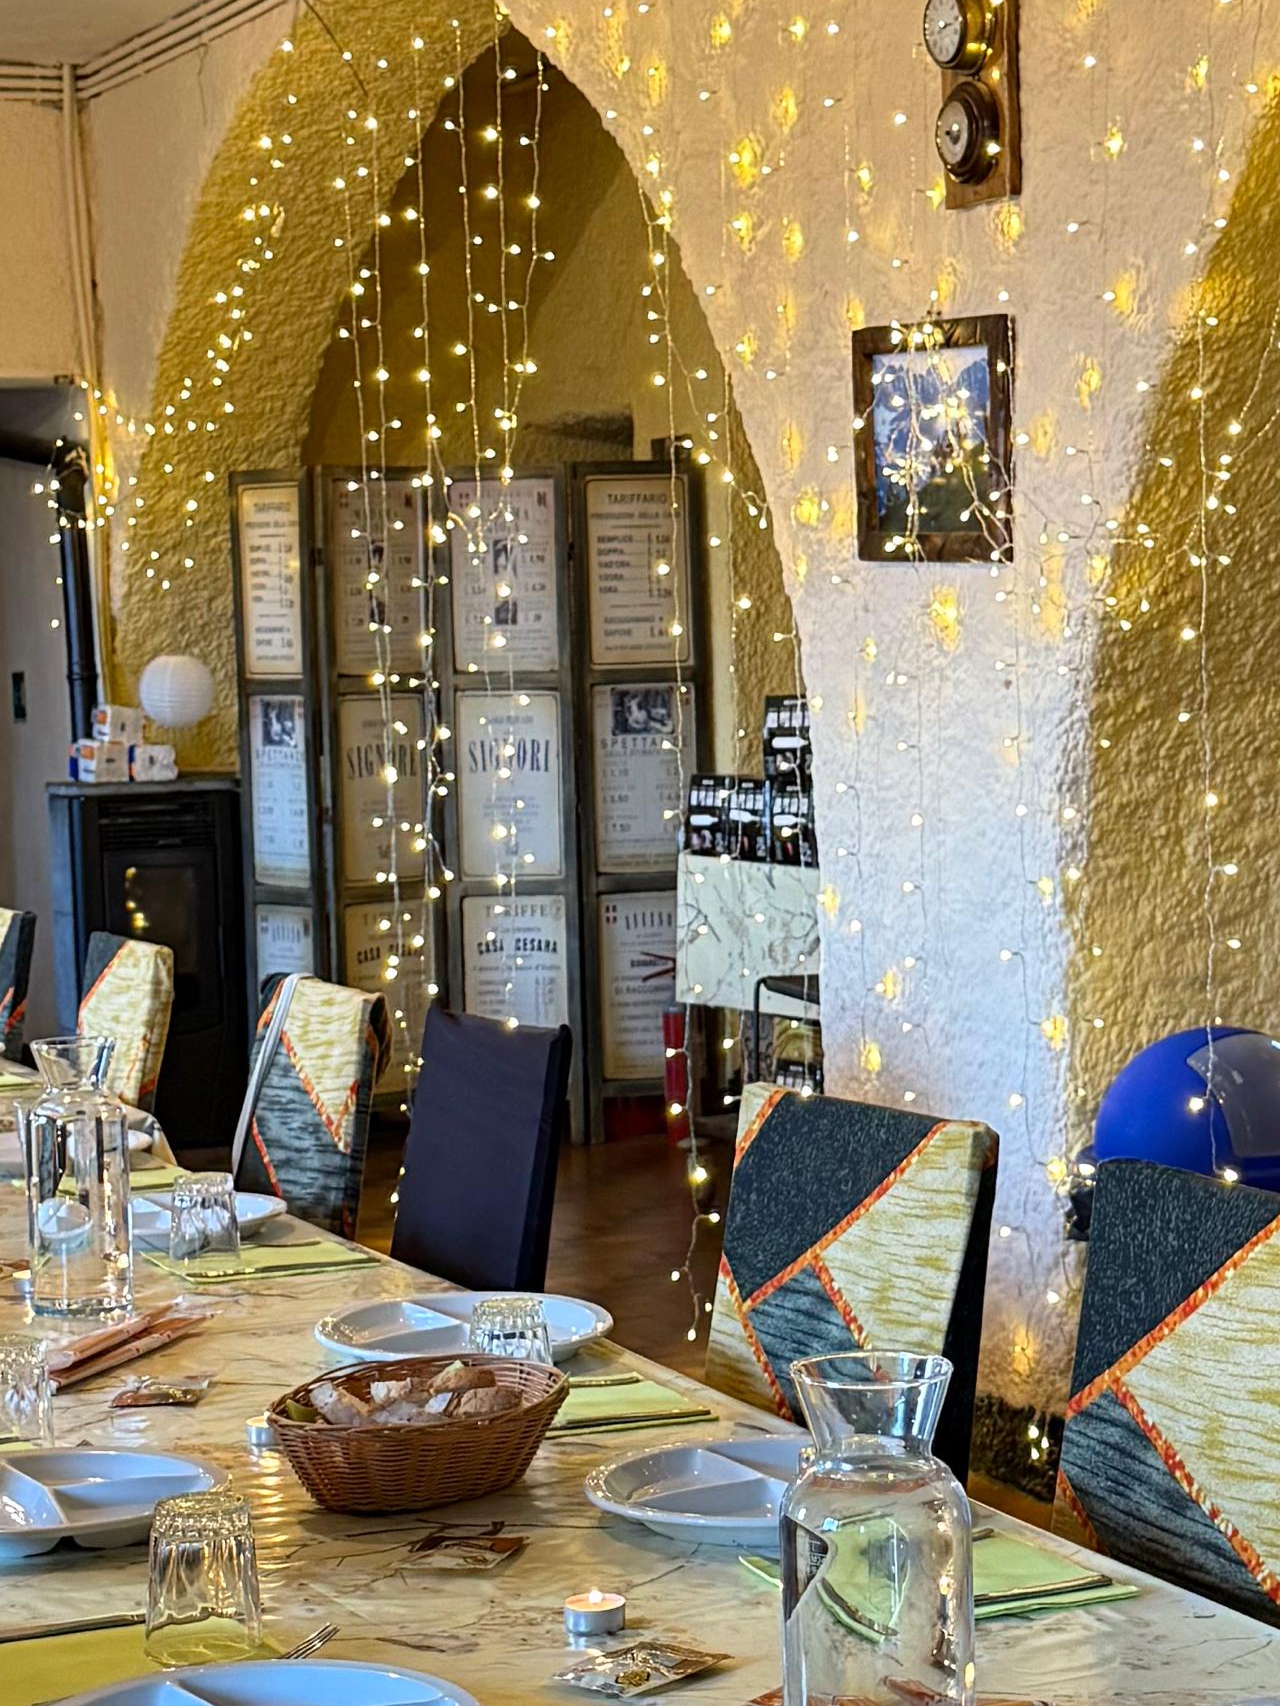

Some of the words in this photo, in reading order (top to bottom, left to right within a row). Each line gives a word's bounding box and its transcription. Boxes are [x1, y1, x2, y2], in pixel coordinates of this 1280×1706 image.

[607, 493, 667, 504] TARIFFARIO
[485, 902, 548, 919] TRIFFE
[477, 938, 504, 955] CASA
